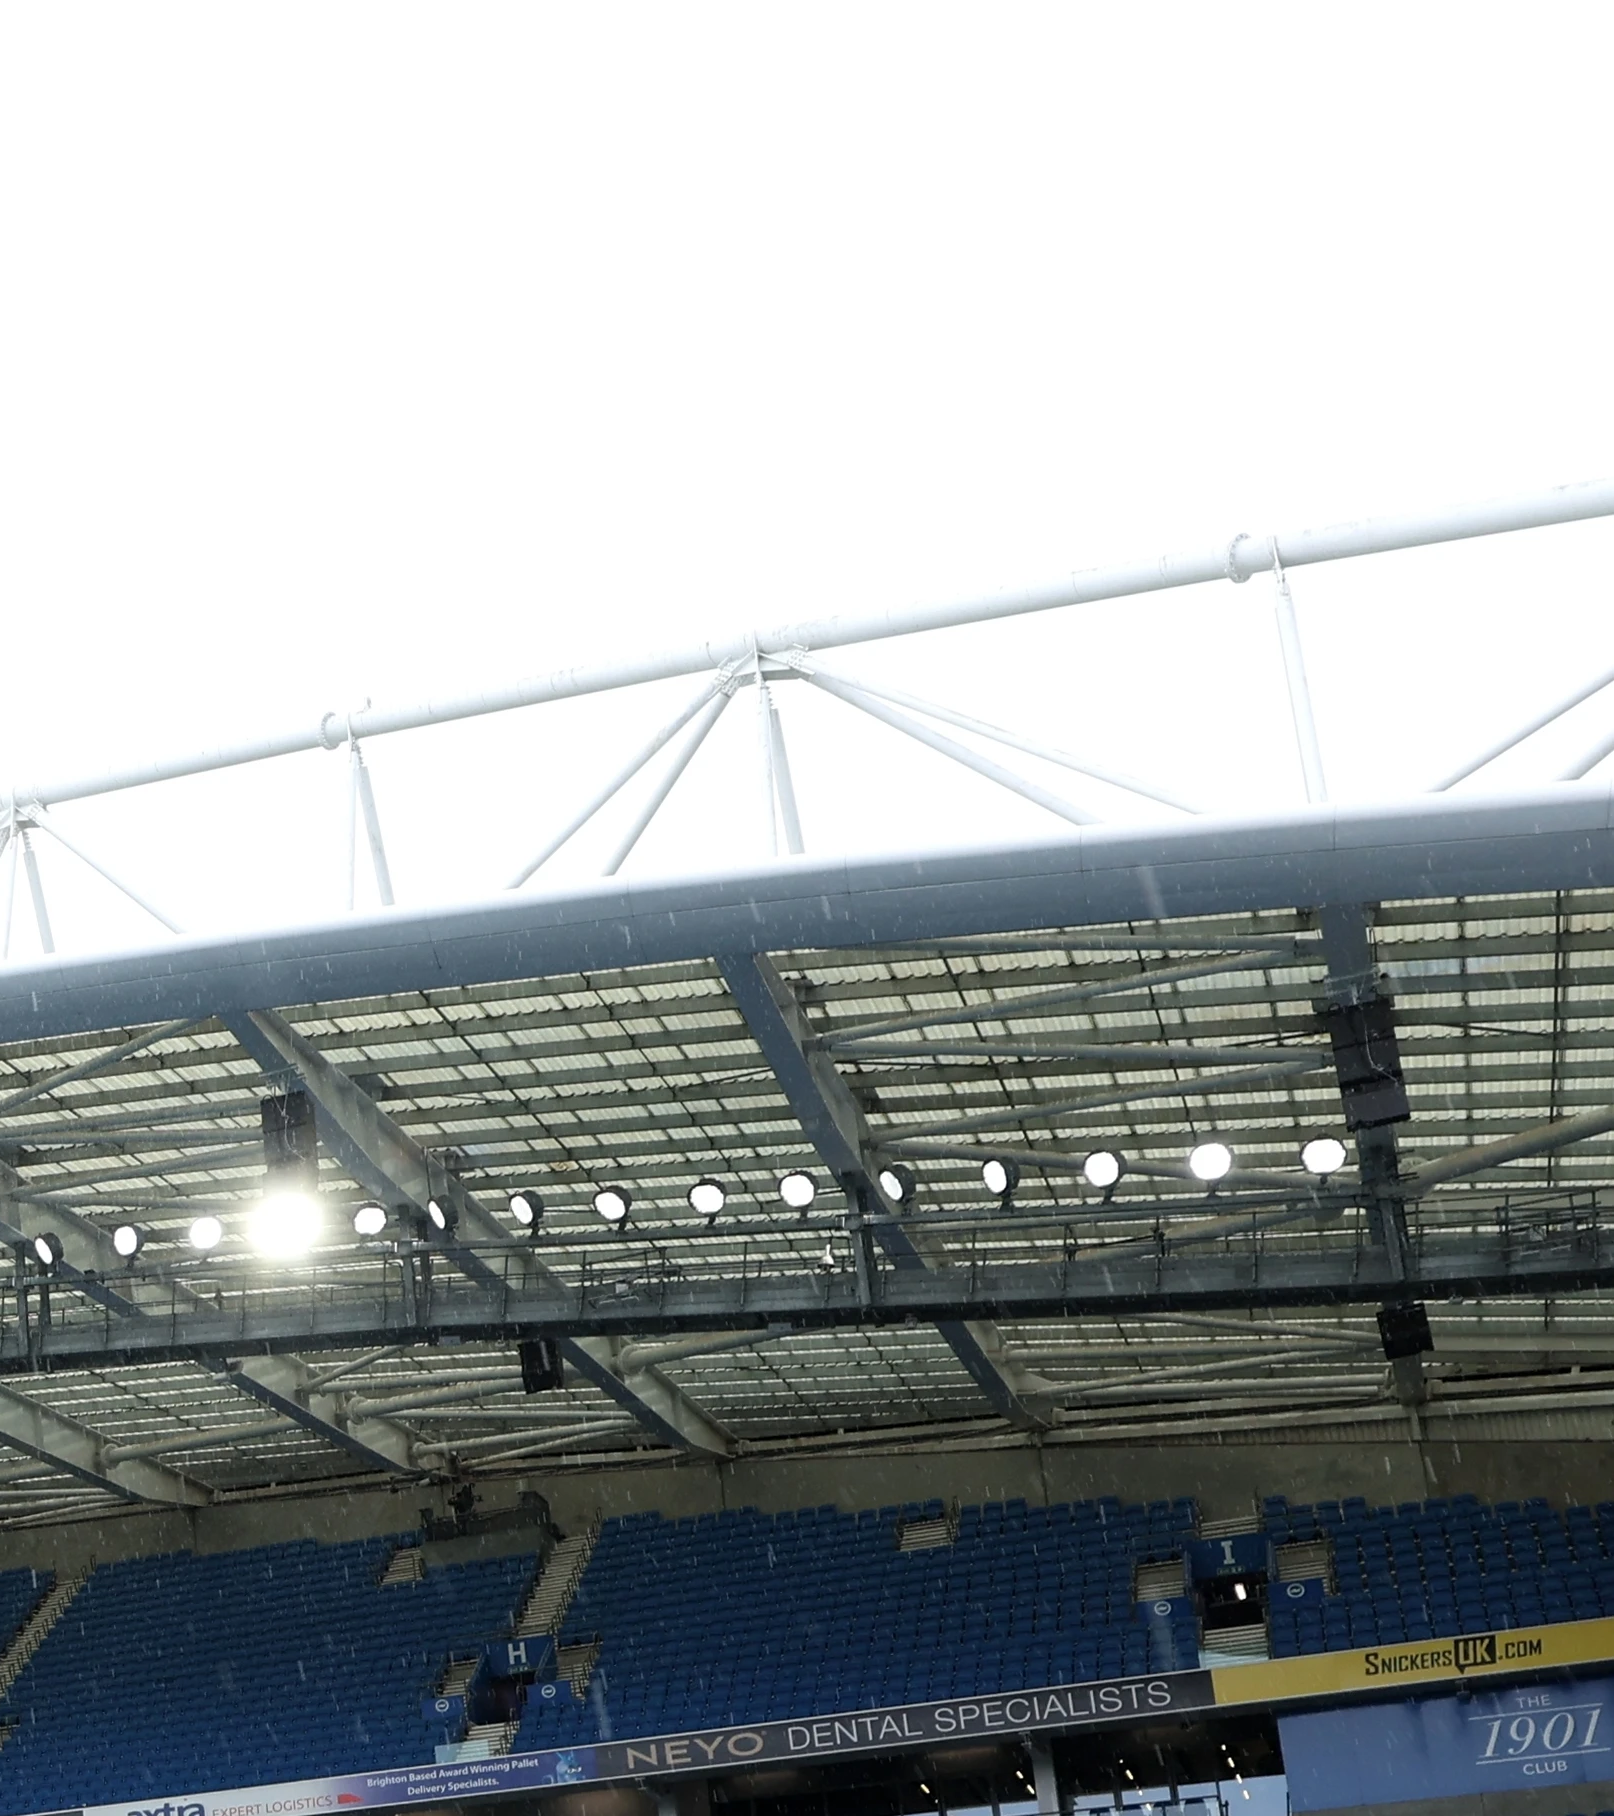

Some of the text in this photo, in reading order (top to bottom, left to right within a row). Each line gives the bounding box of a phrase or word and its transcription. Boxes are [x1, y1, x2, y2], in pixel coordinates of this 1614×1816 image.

[507, 1641, 527, 1665] H
[1519, 1694, 1551, 1709] THE
[626, 1681, 1172, 1769] NEYO DENTAL SPECIALISTS
[1478, 1709, 1602, 1758] 1901
[367, 1757, 539, 1787] Brighton Based Award Winning Pallet
[1523, 1760, 1568, 1775] CLUB
[407, 1777, 500, 1796] Delivery Specialists.
[265, 1795, 333, 1814] LOGISTICS
